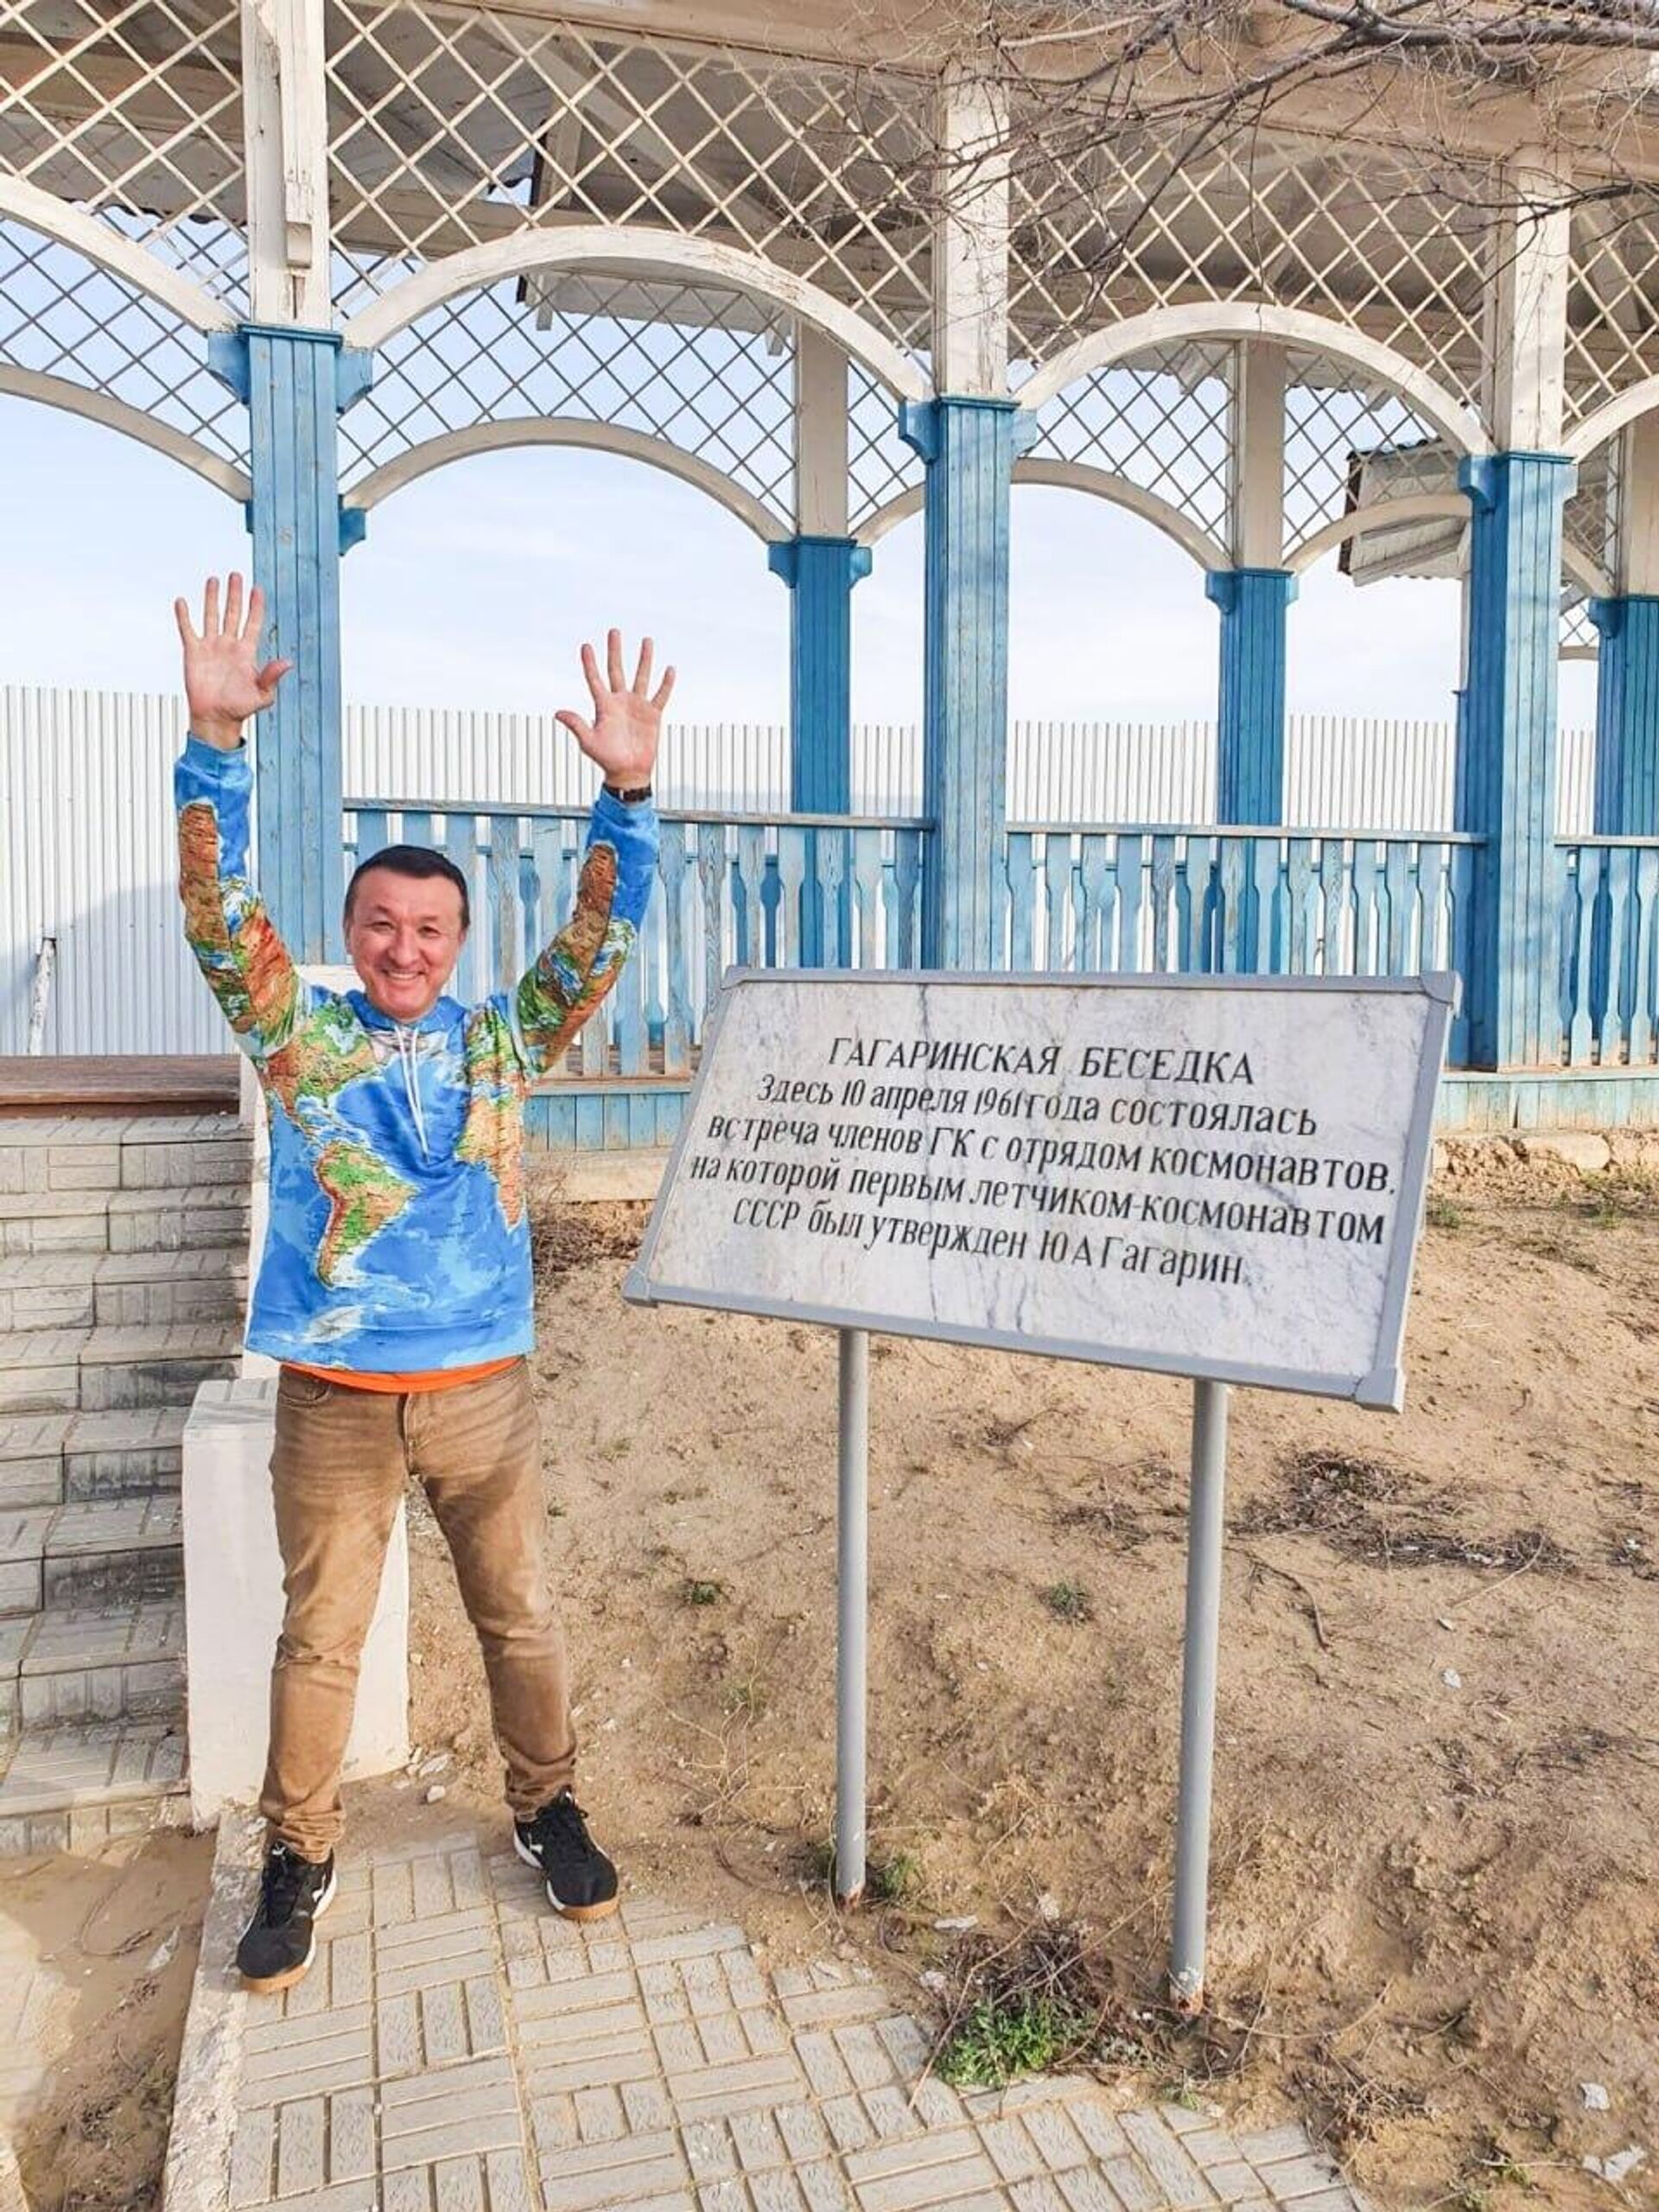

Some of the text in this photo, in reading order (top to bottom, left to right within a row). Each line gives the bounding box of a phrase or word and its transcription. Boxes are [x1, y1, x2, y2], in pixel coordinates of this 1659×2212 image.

[829, 1038, 1254, 1085] ГАГАРИНСКАЯ БЕСЕДКА
[757, 1074, 833, 1105] Здесь
[841, 1080, 865, 1106] 10
[870, 1086, 969, 1120] апреля
[1110, 1098, 1318, 1136] состоялась
[707, 1116, 819, 1150] встреча
[828, 1125, 923, 1154] членов
[930, 1127, 976, 1158] ГК
[981, 1135, 1000, 1160] с
[1006, 1136, 1141, 1174] отрядом
[690, 1155, 1385, 1245] на которой первым летчиком-космонавтом
[734, 1198, 800, 1230] СССР
[808, 1198, 863, 1238] был
[863, 1216, 1027, 1260] утвержден
